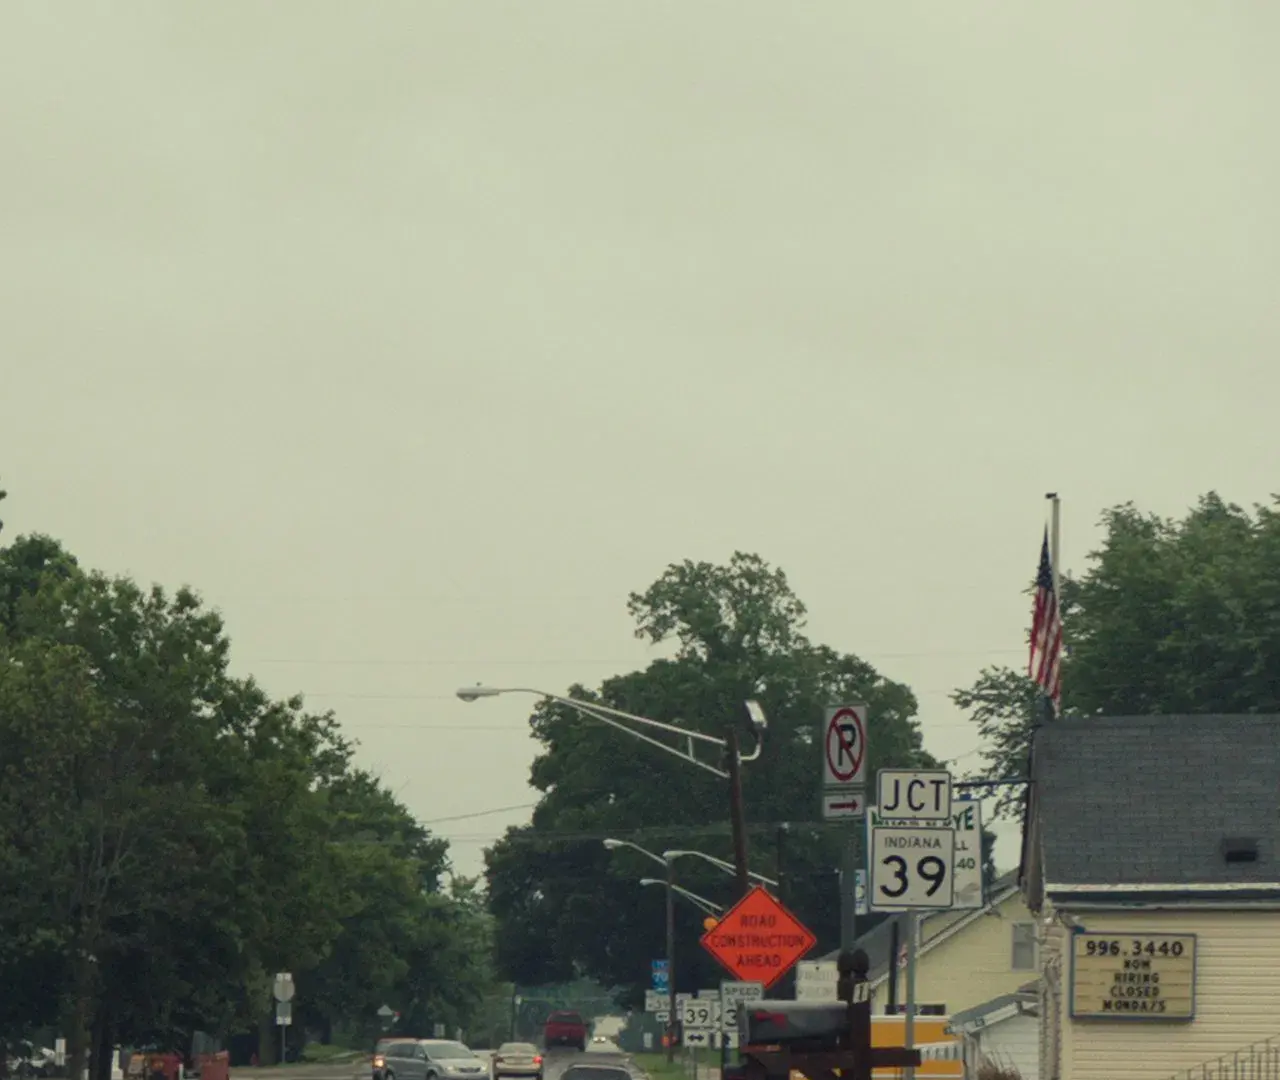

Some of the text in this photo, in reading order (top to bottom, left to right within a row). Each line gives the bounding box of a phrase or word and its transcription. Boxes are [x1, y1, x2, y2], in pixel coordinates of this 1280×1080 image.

[883, 779, 947, 812] JCT
[884, 836, 943, 849] INDIANA
[880, 854, 947, 898] 39
[740, 914, 778, 928] ROAD
[711, 934, 805, 948] CONSTRUCTION
[1086, 940, 1184, 956] 996.3440
[736, 954, 782, 968] AHEAD
[1114, 972, 1160, 983] HIRING
[724, 987, 761, 996] SPEED
[1110, 986, 1160, 998] CLOSED
[685, 1009, 709, 1024] 39
